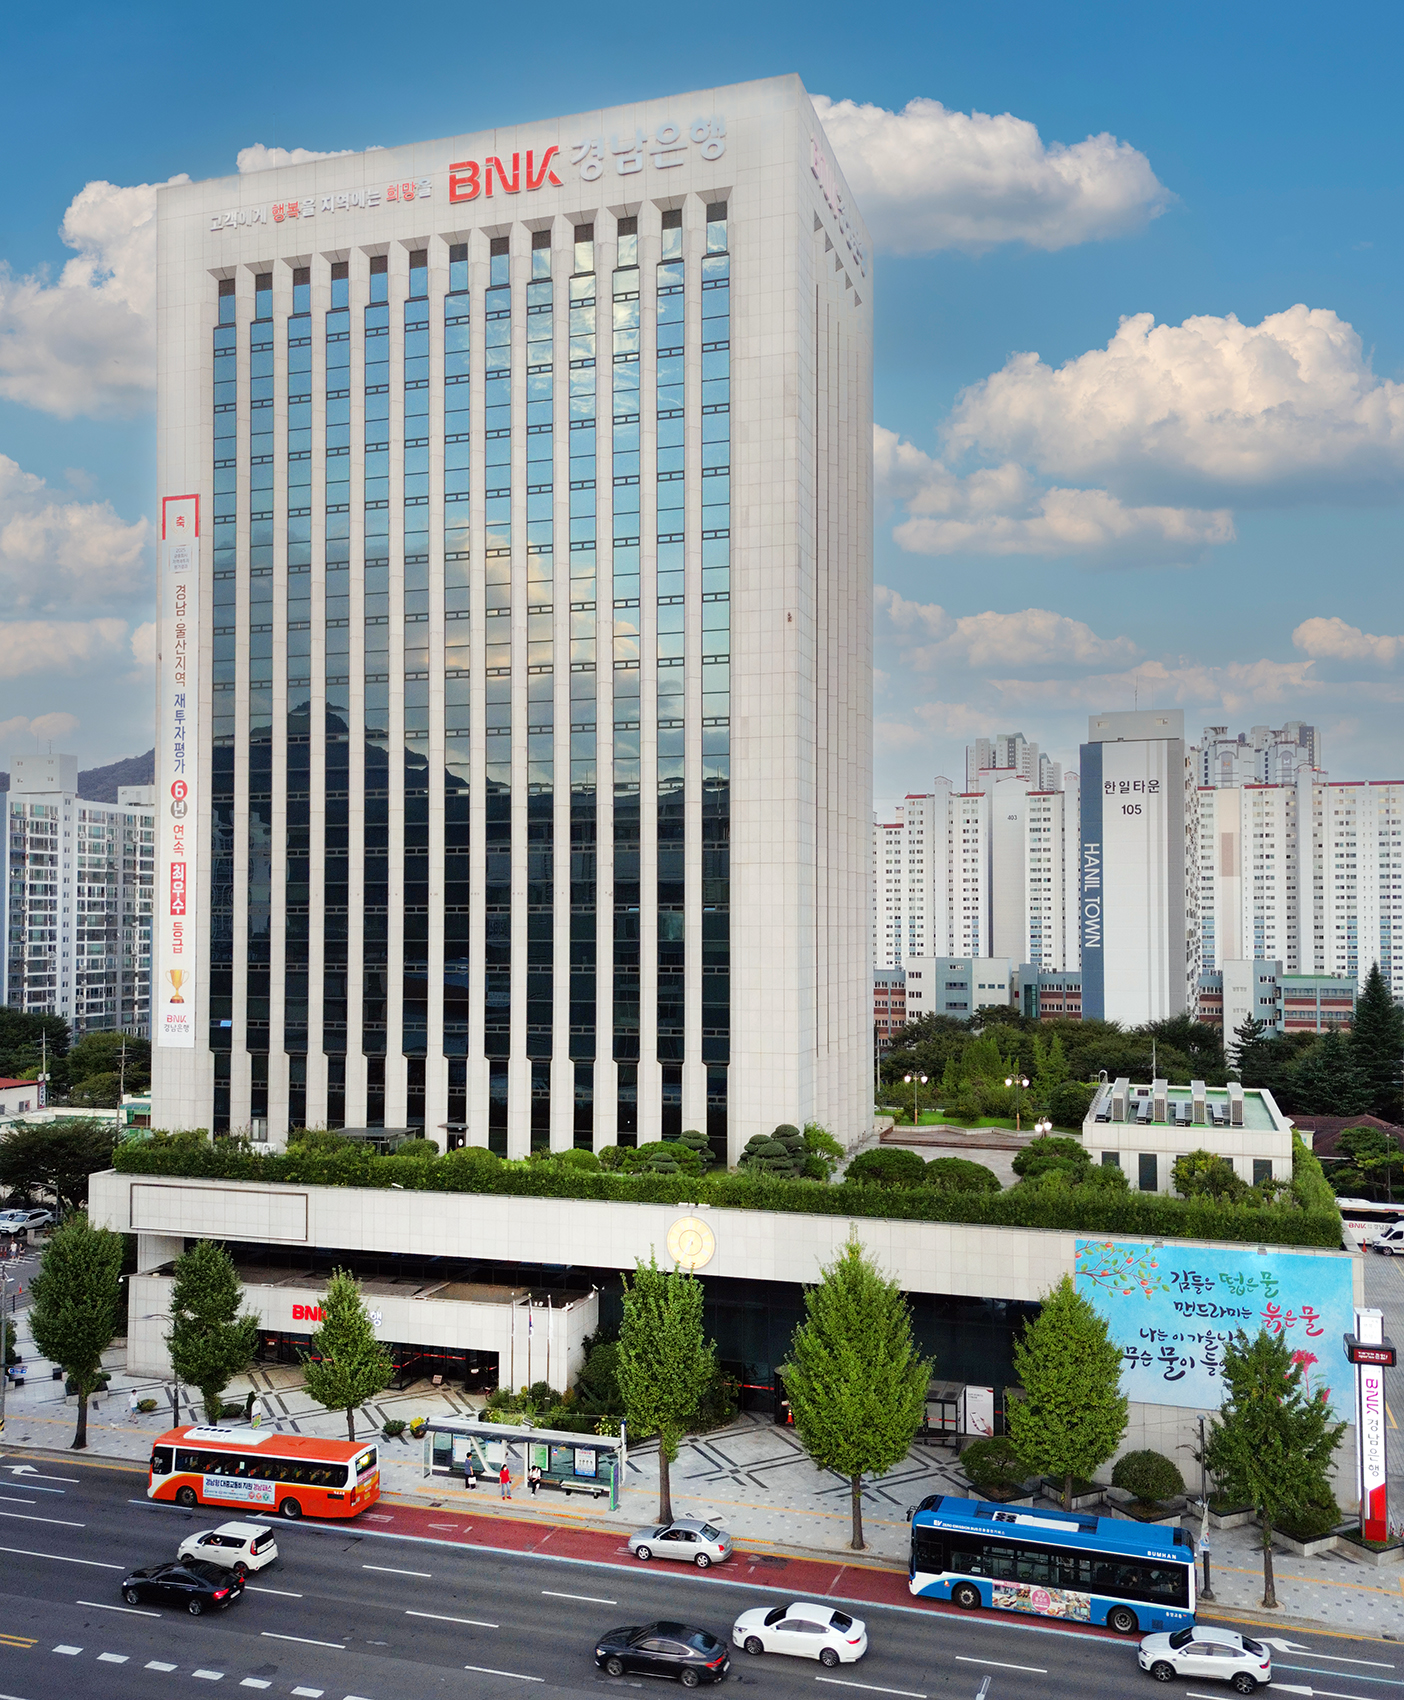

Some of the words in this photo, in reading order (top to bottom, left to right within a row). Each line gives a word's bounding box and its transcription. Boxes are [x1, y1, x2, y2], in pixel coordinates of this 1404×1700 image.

[570, 115, 728, 182] 경남은행
[447, 144, 564, 204] BNK
[210, 206, 267, 231] 고객에게
[272, 200, 315, 222] 행복을
[321, 188, 381, 213] 지역에는
[386, 177, 432, 202] 희망을
[176, 515, 185, 528] 축
[174, 693, 186, 774] 재투자평가
[1104, 779, 1160, 794] 한일타운
[1121, 804, 1142, 815] 105
[173, 824, 185, 857] 연속
[1084, 843, 1100, 892] HANIL
[171, 863, 186, 915] 최우수
[171, 922, 184, 954] 등급
[1084, 896, 1101, 948] TOWN
[163, 1024, 190, 1033] 경남은행
[166, 1014, 187, 1023] BNK
[1170, 1269, 1215, 1294] 감들은
[1219, 1271, 1259, 1296] 떫은
[1260, 1271, 1279, 1298] 물
[1140, 1328, 1168, 1342] 나는
[1173, 1301, 1252, 1319] 맨드라미는
[1260, 1302, 1297, 1333] 붉은
[1299, 1305, 1324, 1337] 물
[1123, 1346, 1153, 1369] 무슨
[1157, 1346, 1195, 1381] 물이
[1365, 1378, 1379, 1415] BNK
[1367, 1419, 1379, 1477] 경남은행
[1147, 1551, 1177, 1559] BUMHAN
